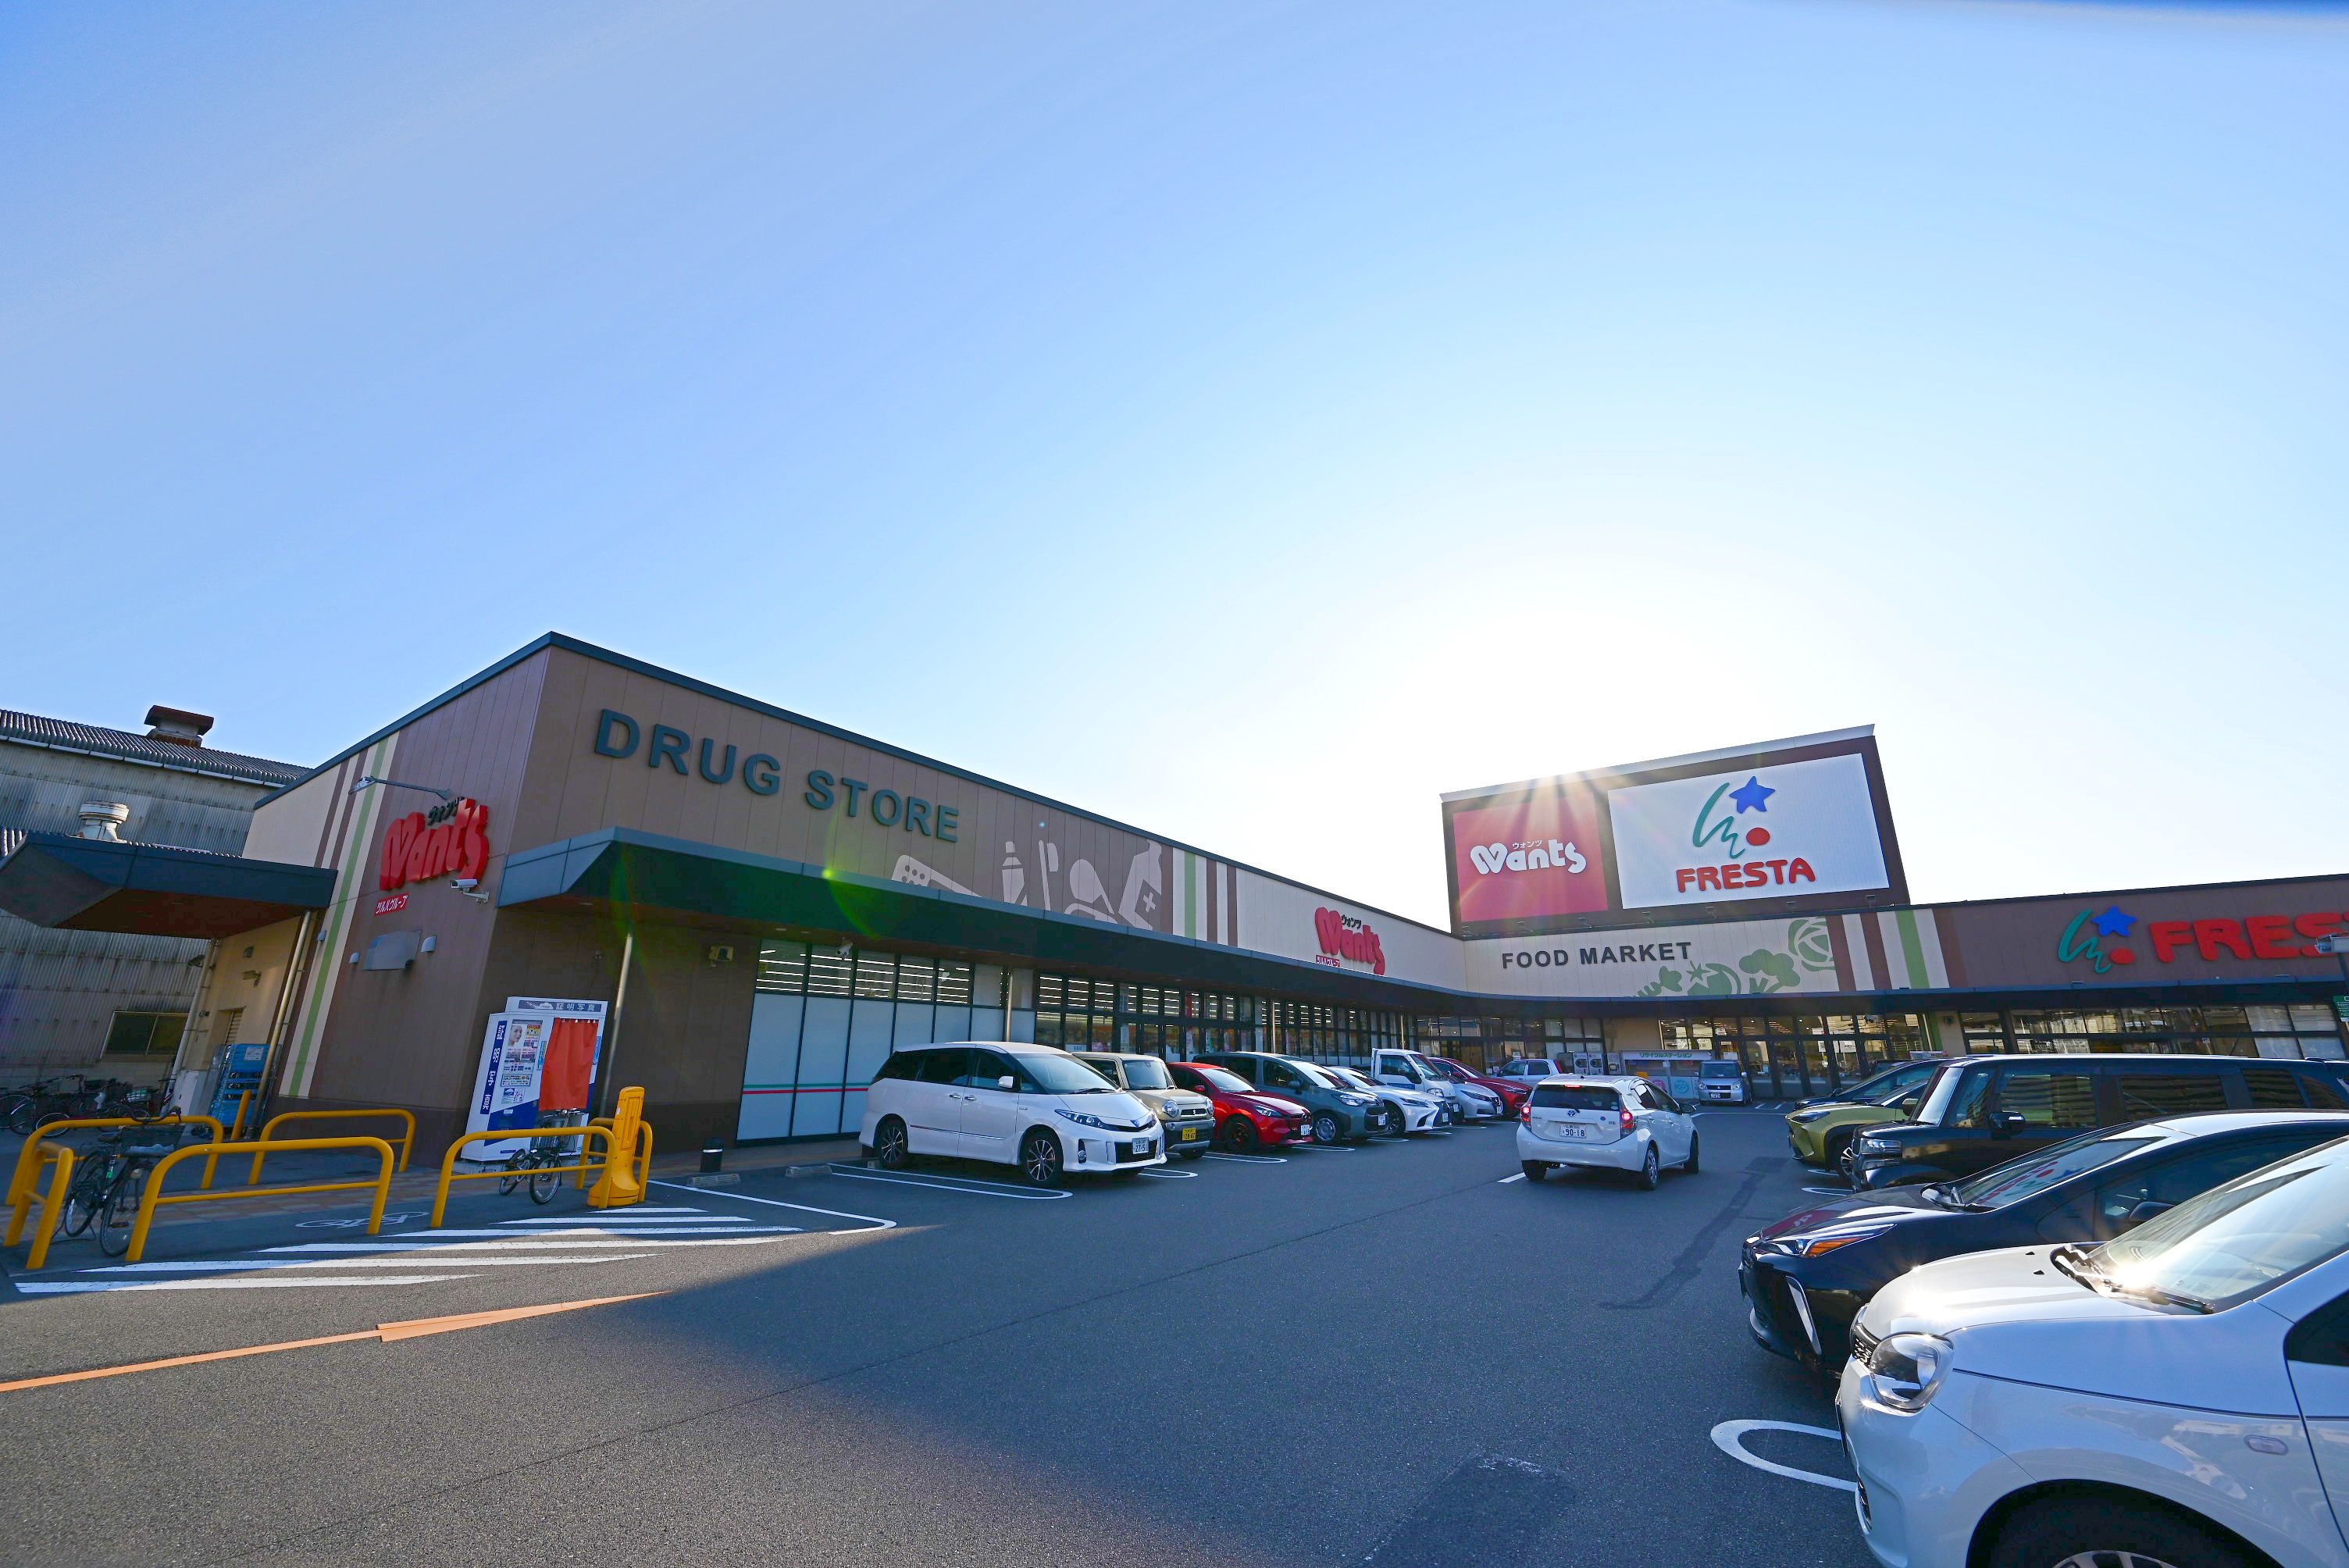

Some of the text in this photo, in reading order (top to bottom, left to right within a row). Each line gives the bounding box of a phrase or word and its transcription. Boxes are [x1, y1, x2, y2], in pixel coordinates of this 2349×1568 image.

[594, 708, 960, 843] DRUG STORE
[380, 798, 490, 892] Wants
[1470, 839, 1587, 875] Wants
[1512, 839, 1542, 850] ウォンツ
[1676, 857, 1816, 893] FRESTA
[1314, 907, 1385, 976] Wants
[1502, 942, 1691, 969] FOOD MARKET
[2150, 911, 2349, 964] FRES
